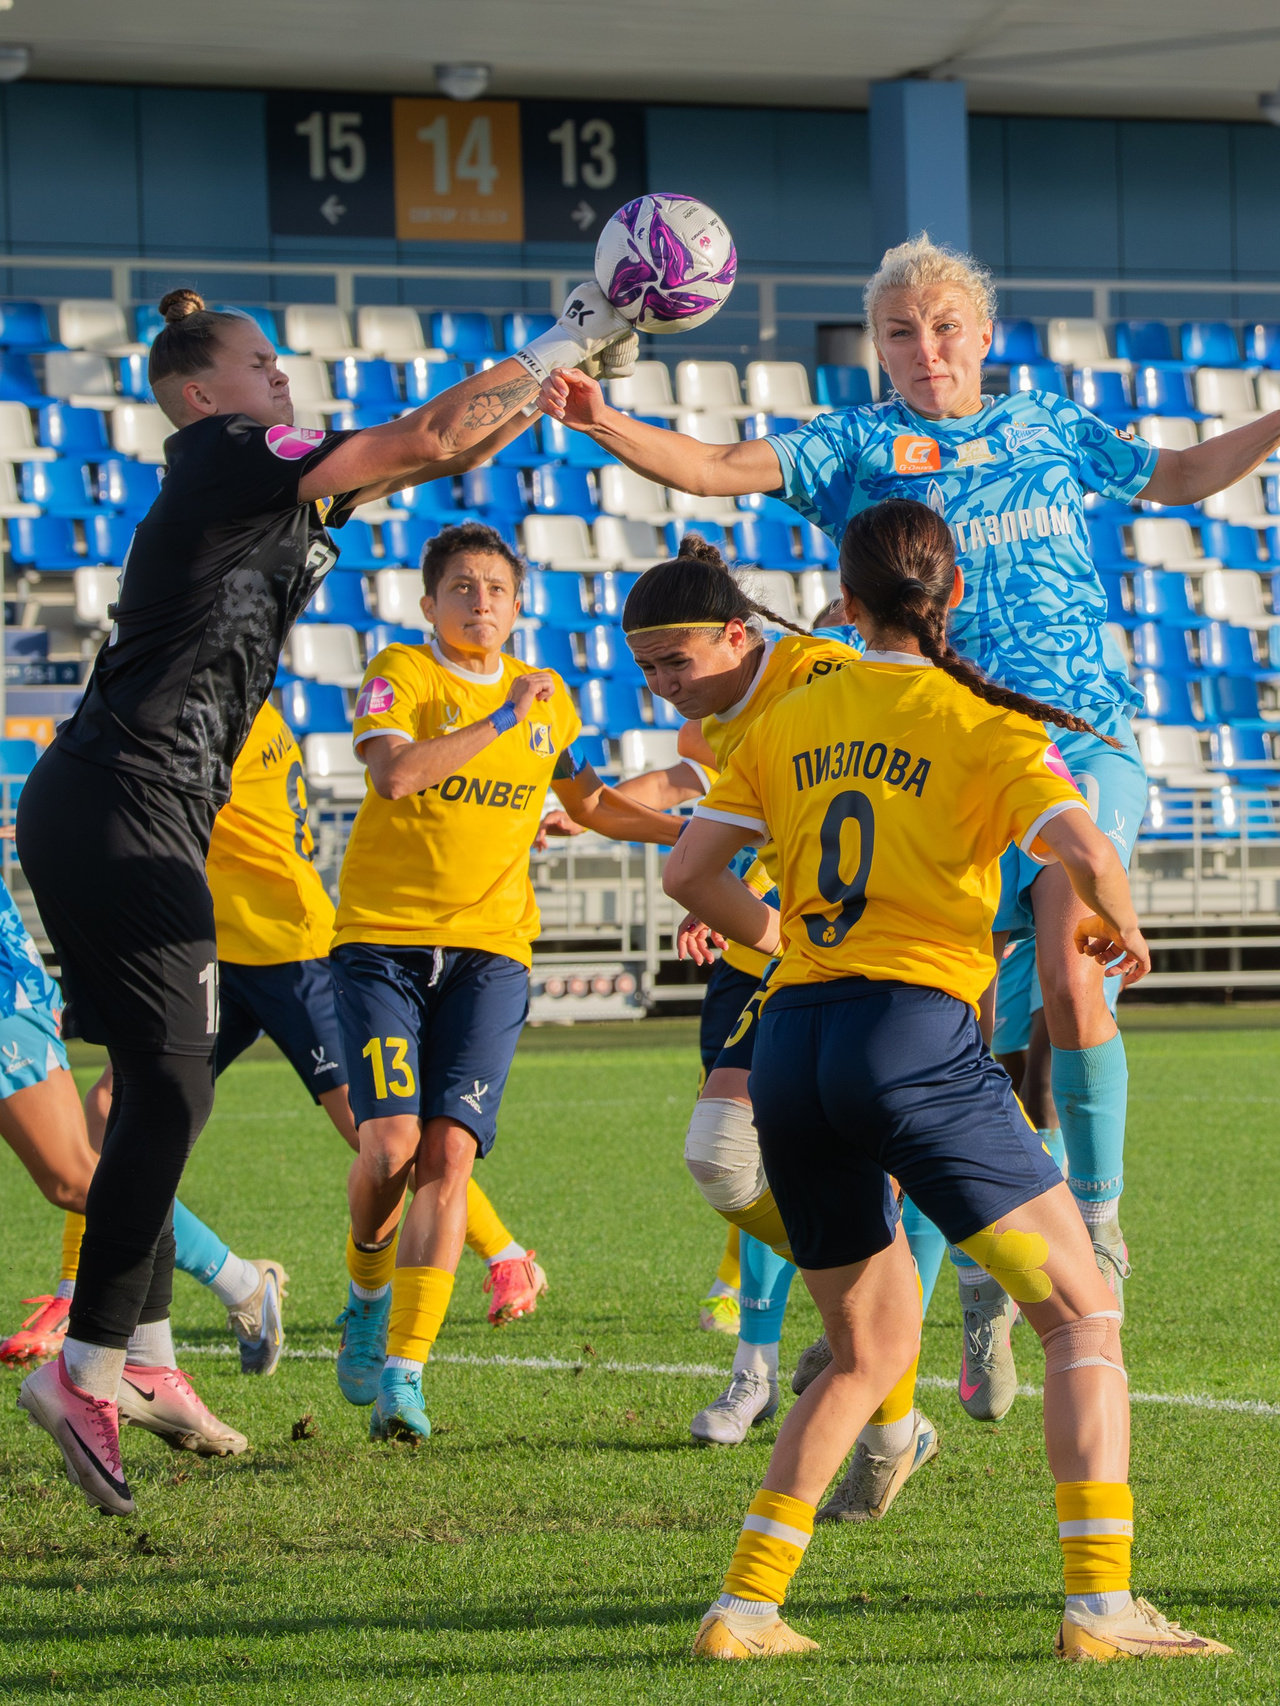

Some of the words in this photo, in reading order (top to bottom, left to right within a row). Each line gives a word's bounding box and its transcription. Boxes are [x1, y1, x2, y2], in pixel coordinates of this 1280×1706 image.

[296, 111, 367, 183] 15
[416, 115, 499, 197] 14
[548, 118, 618, 190] 13
[955, 504, 1072, 553] ГАЗПРОМ
[792, 740, 932, 798] ПИЗЛОВА
[800, 789, 876, 948] 9
[362, 1036, 417, 1100] 13
